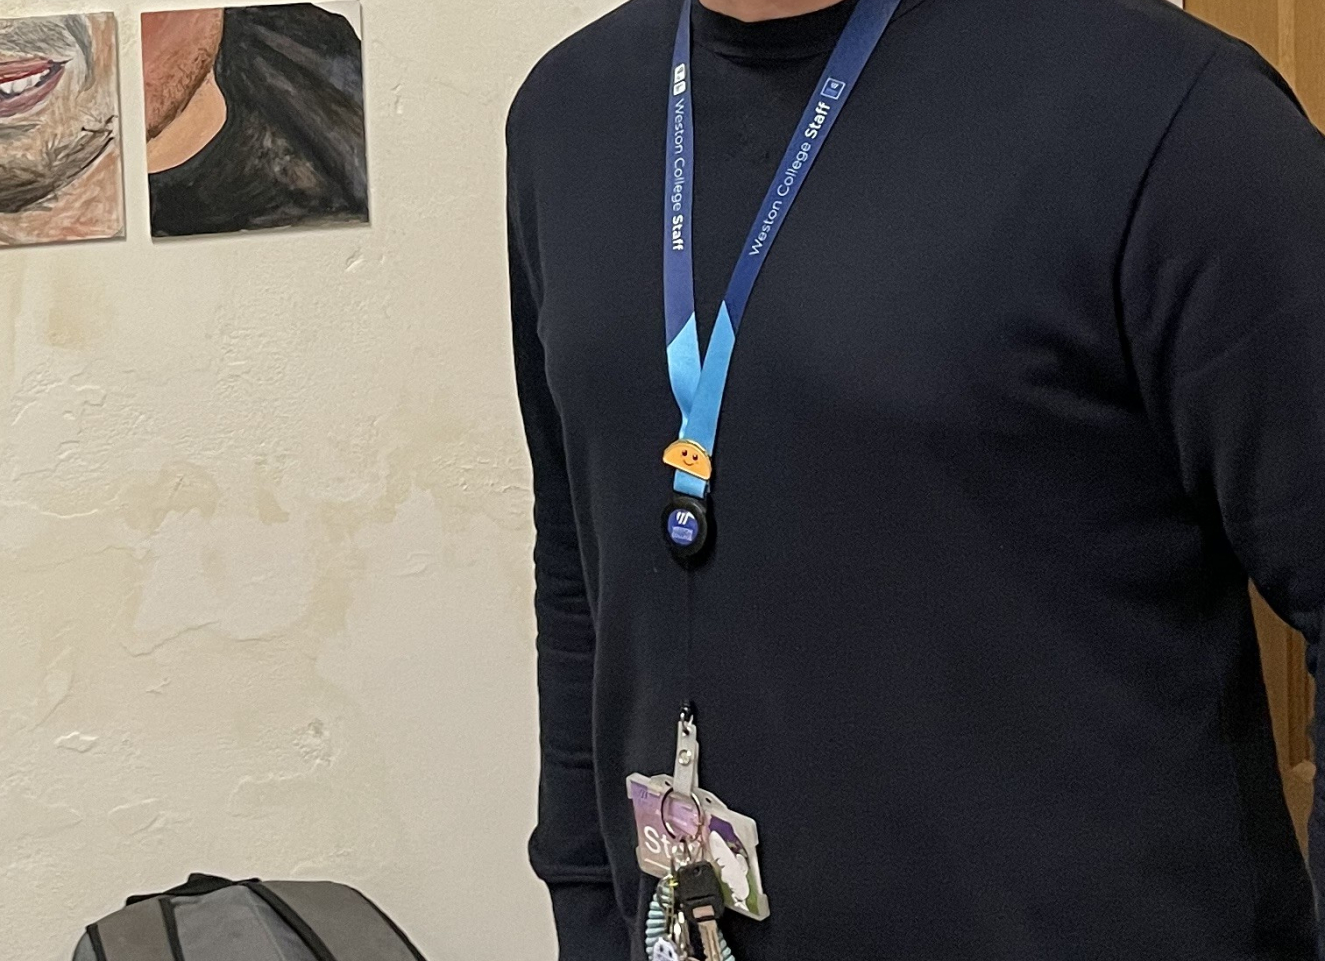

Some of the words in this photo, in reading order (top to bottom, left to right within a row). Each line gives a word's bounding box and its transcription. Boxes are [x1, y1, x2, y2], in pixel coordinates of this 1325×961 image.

[673, 97, 685, 155] Weston
[671, 157, 686, 211] College
[748, 199, 783, 256] Weston
[776, 141, 811, 198] College
[804, 101, 831, 139] Staff
[672, 214, 684, 251] Staff
